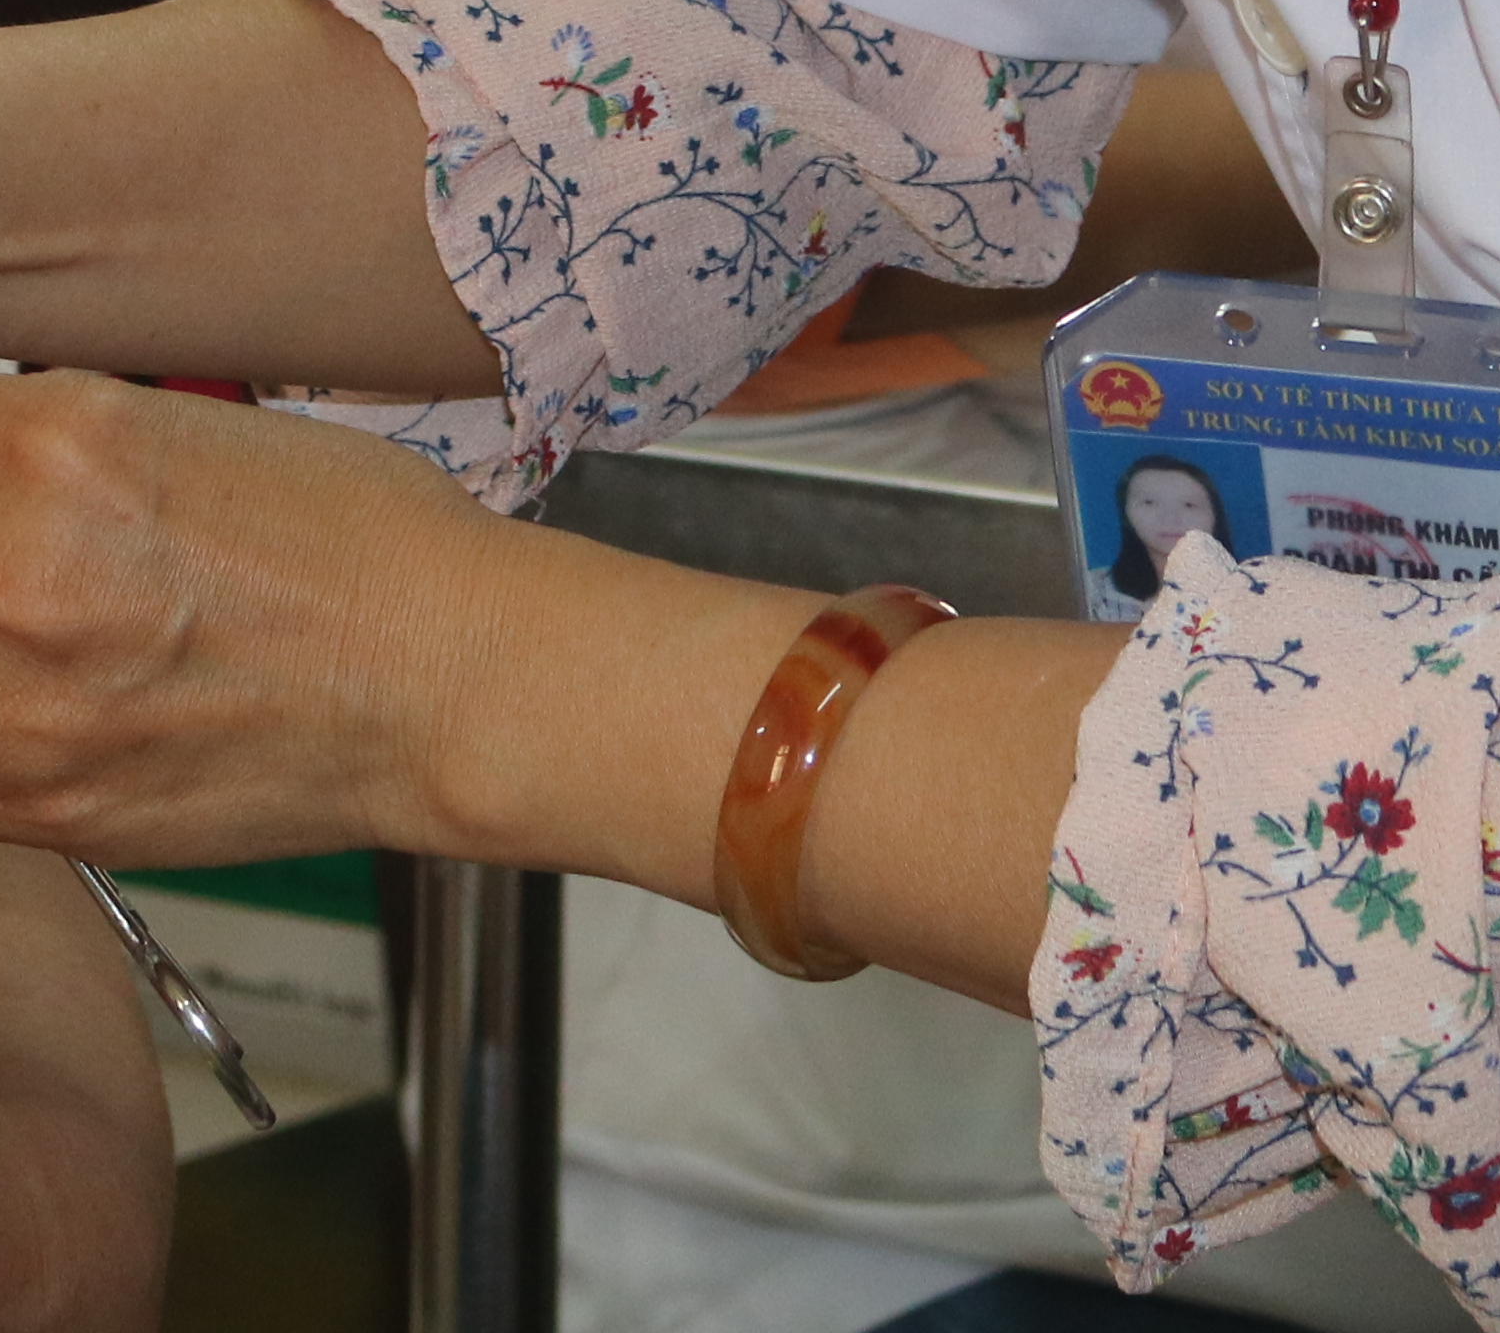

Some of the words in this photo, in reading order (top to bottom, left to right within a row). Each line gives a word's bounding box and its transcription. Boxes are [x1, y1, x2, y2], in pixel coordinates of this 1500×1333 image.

[1251, 384, 1268, 403] Y
[1183, 409, 1284, 436] TRUNG
[1414, 520, 1500, 551] KHÁM
